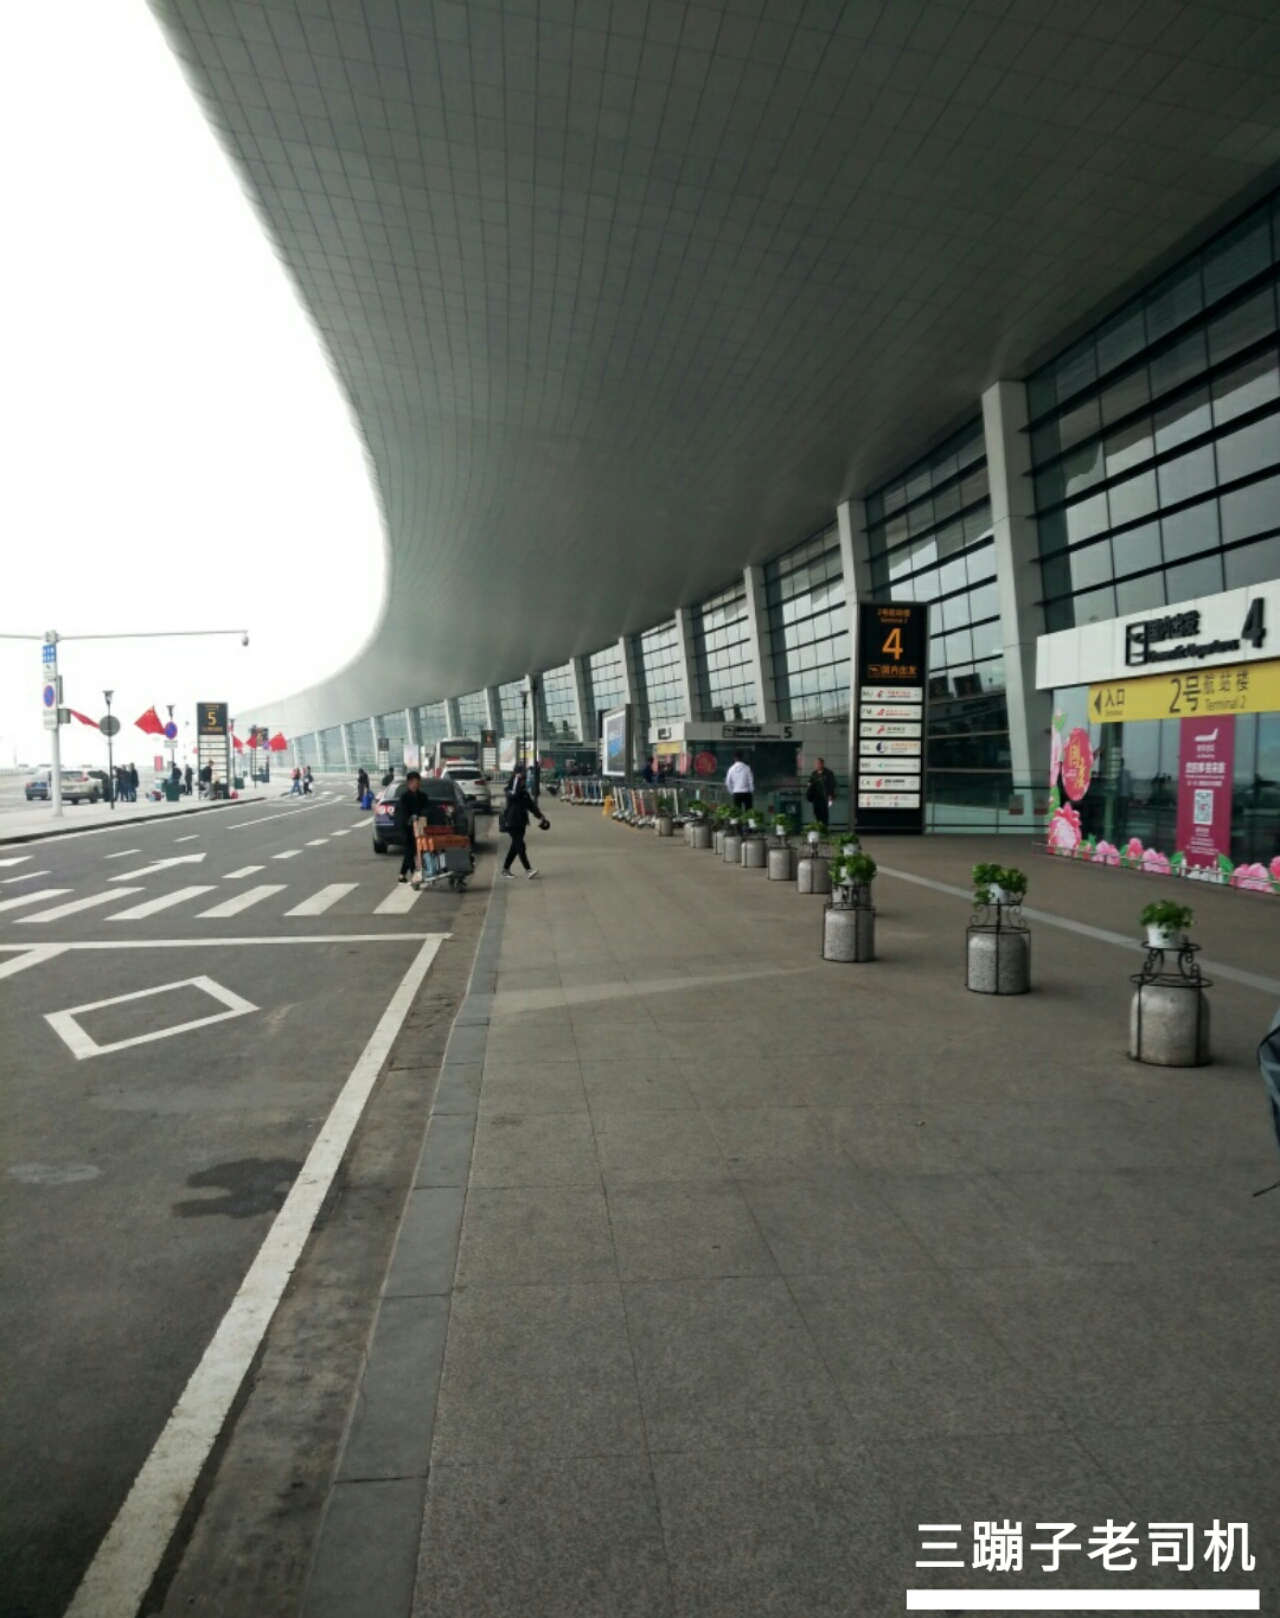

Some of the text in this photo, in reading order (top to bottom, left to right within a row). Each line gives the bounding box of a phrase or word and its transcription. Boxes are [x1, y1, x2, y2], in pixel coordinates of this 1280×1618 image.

[1241, 597, 1267, 648] 4
[882, 627, 904, 660] 4
[881, 665, 917, 675] 国内出发
[1105, 688, 1125, 707] 入口
[1205, 695, 1246, 711] Terminal 2
[207, 711, 217, 726] 5
[784, 726, 793, 738] 5
